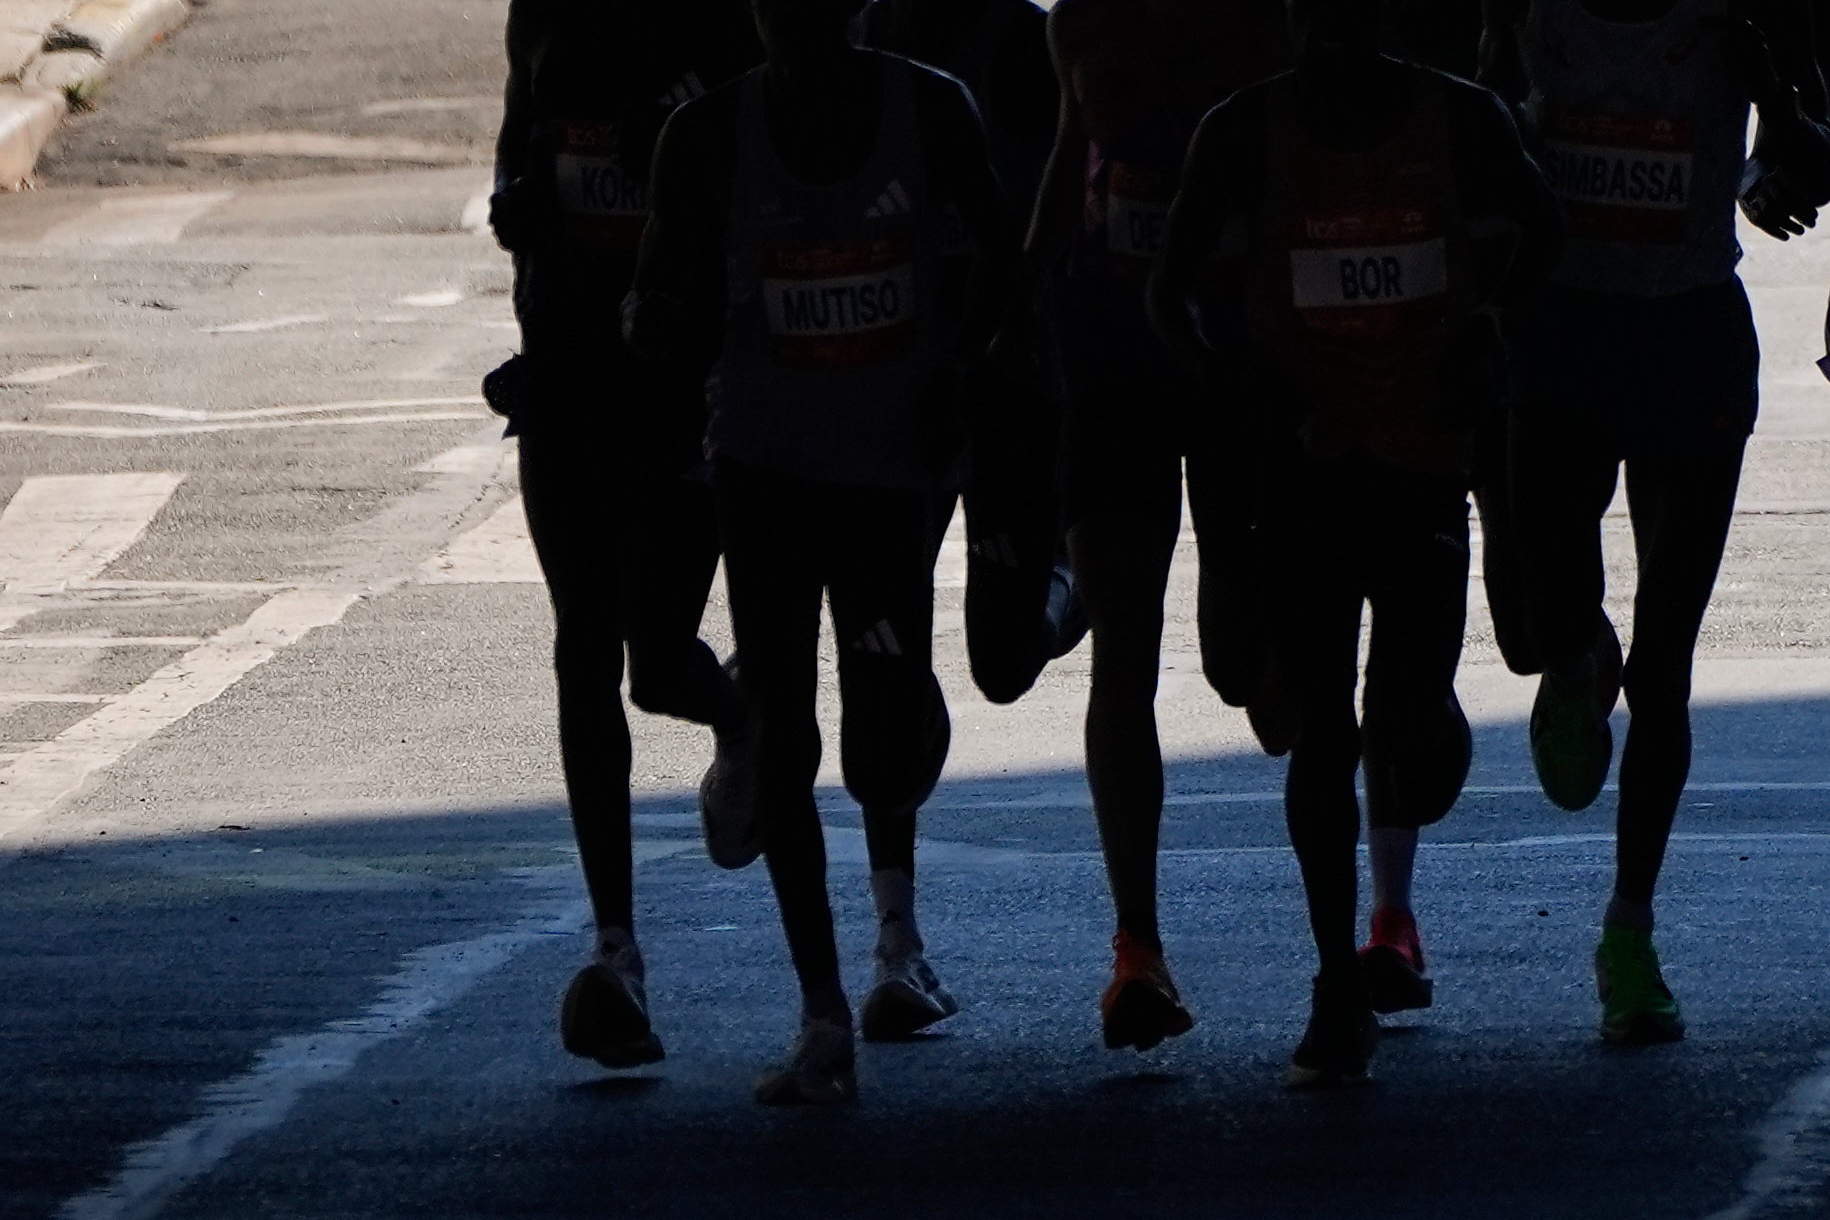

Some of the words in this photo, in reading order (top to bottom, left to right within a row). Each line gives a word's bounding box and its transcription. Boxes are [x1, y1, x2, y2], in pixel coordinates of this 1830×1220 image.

[1546, 150, 1684, 204] SIMBASSA
[1339, 256, 1404, 300] BOR
[782, 279, 899, 331] MUTISO
